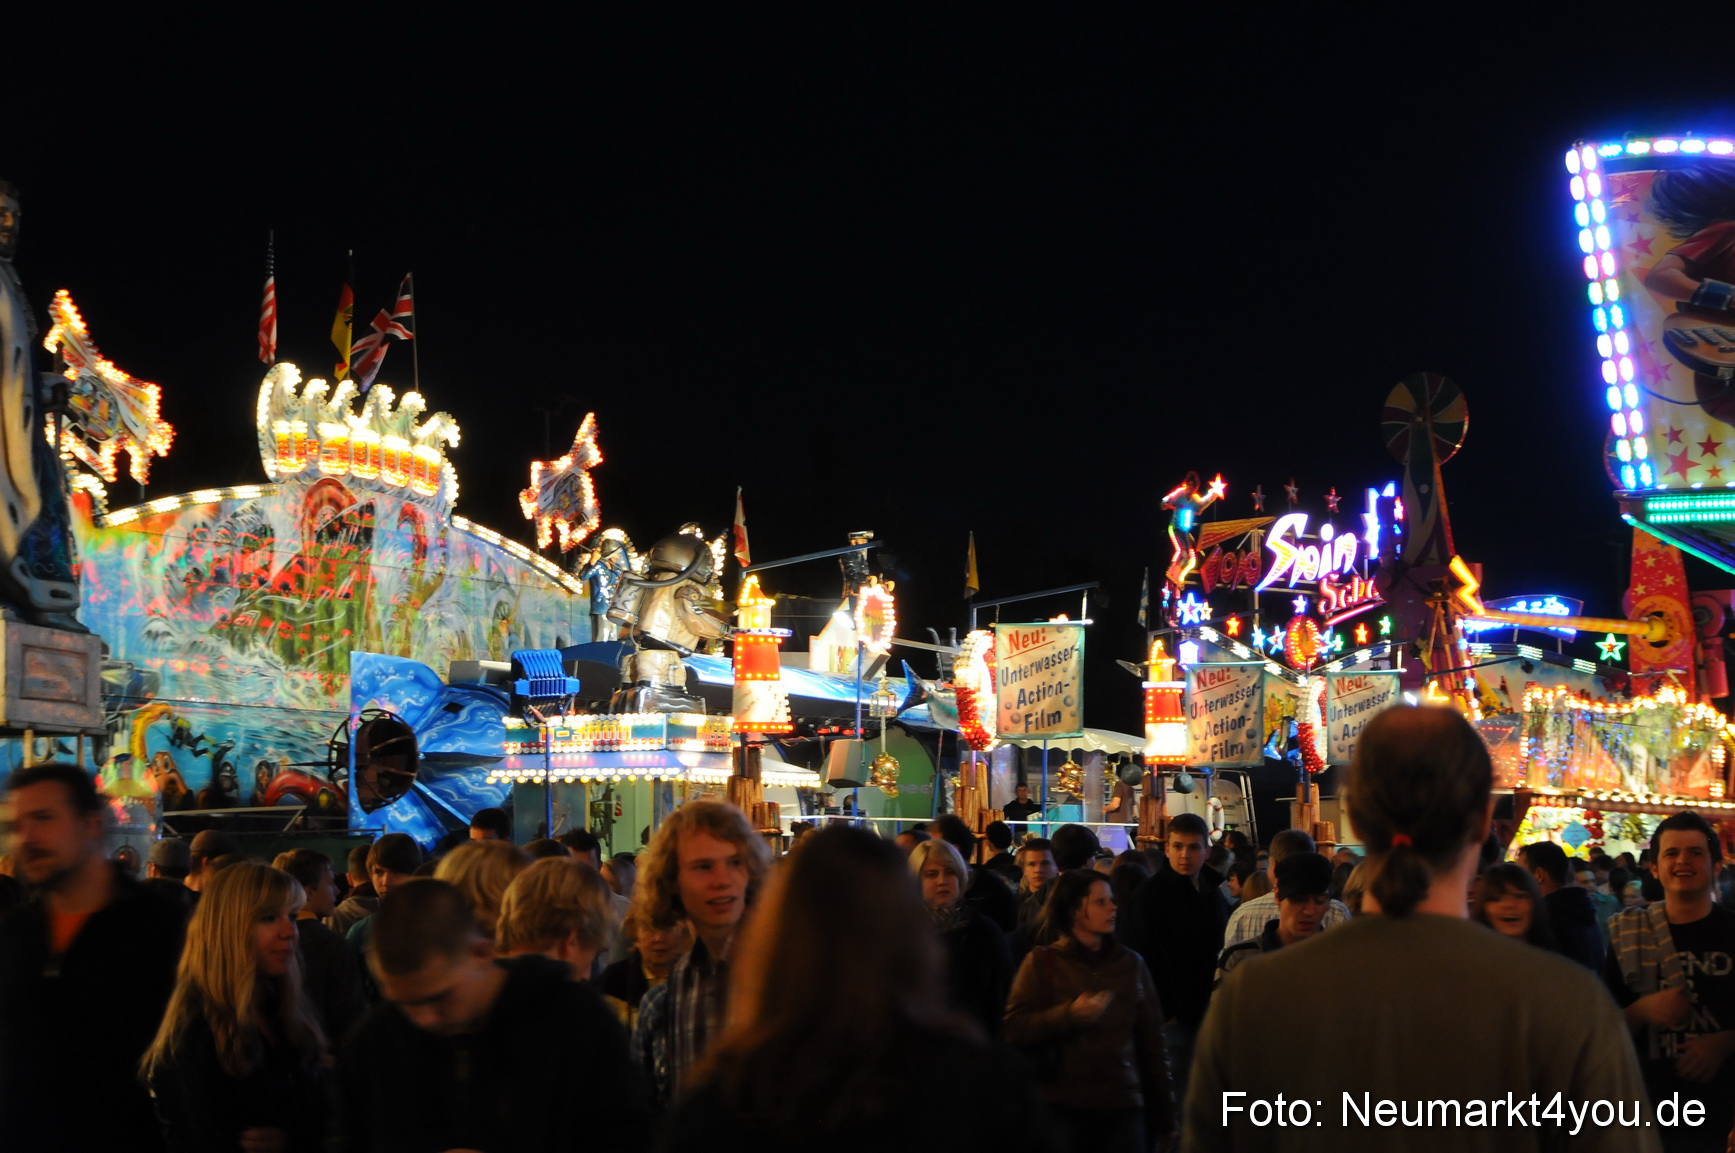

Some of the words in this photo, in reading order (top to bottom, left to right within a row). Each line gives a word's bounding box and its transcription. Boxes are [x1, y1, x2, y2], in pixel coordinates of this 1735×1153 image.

[1255, 513, 1357, 592] Spin
[1008, 627, 1047, 654] Neu:
[1001, 645, 1080, 687] Unterwasser-
[1197, 667, 1231, 689] Neu:
[1016, 680, 1070, 709] Action-
[1336, 675, 1368, 696] Neu:
[1190, 683, 1262, 720] Unterwasser-
[1024, 709, 1062, 733] Film
[1204, 715, 1252, 740] Action-
[1211, 740, 1245, 762] Film
